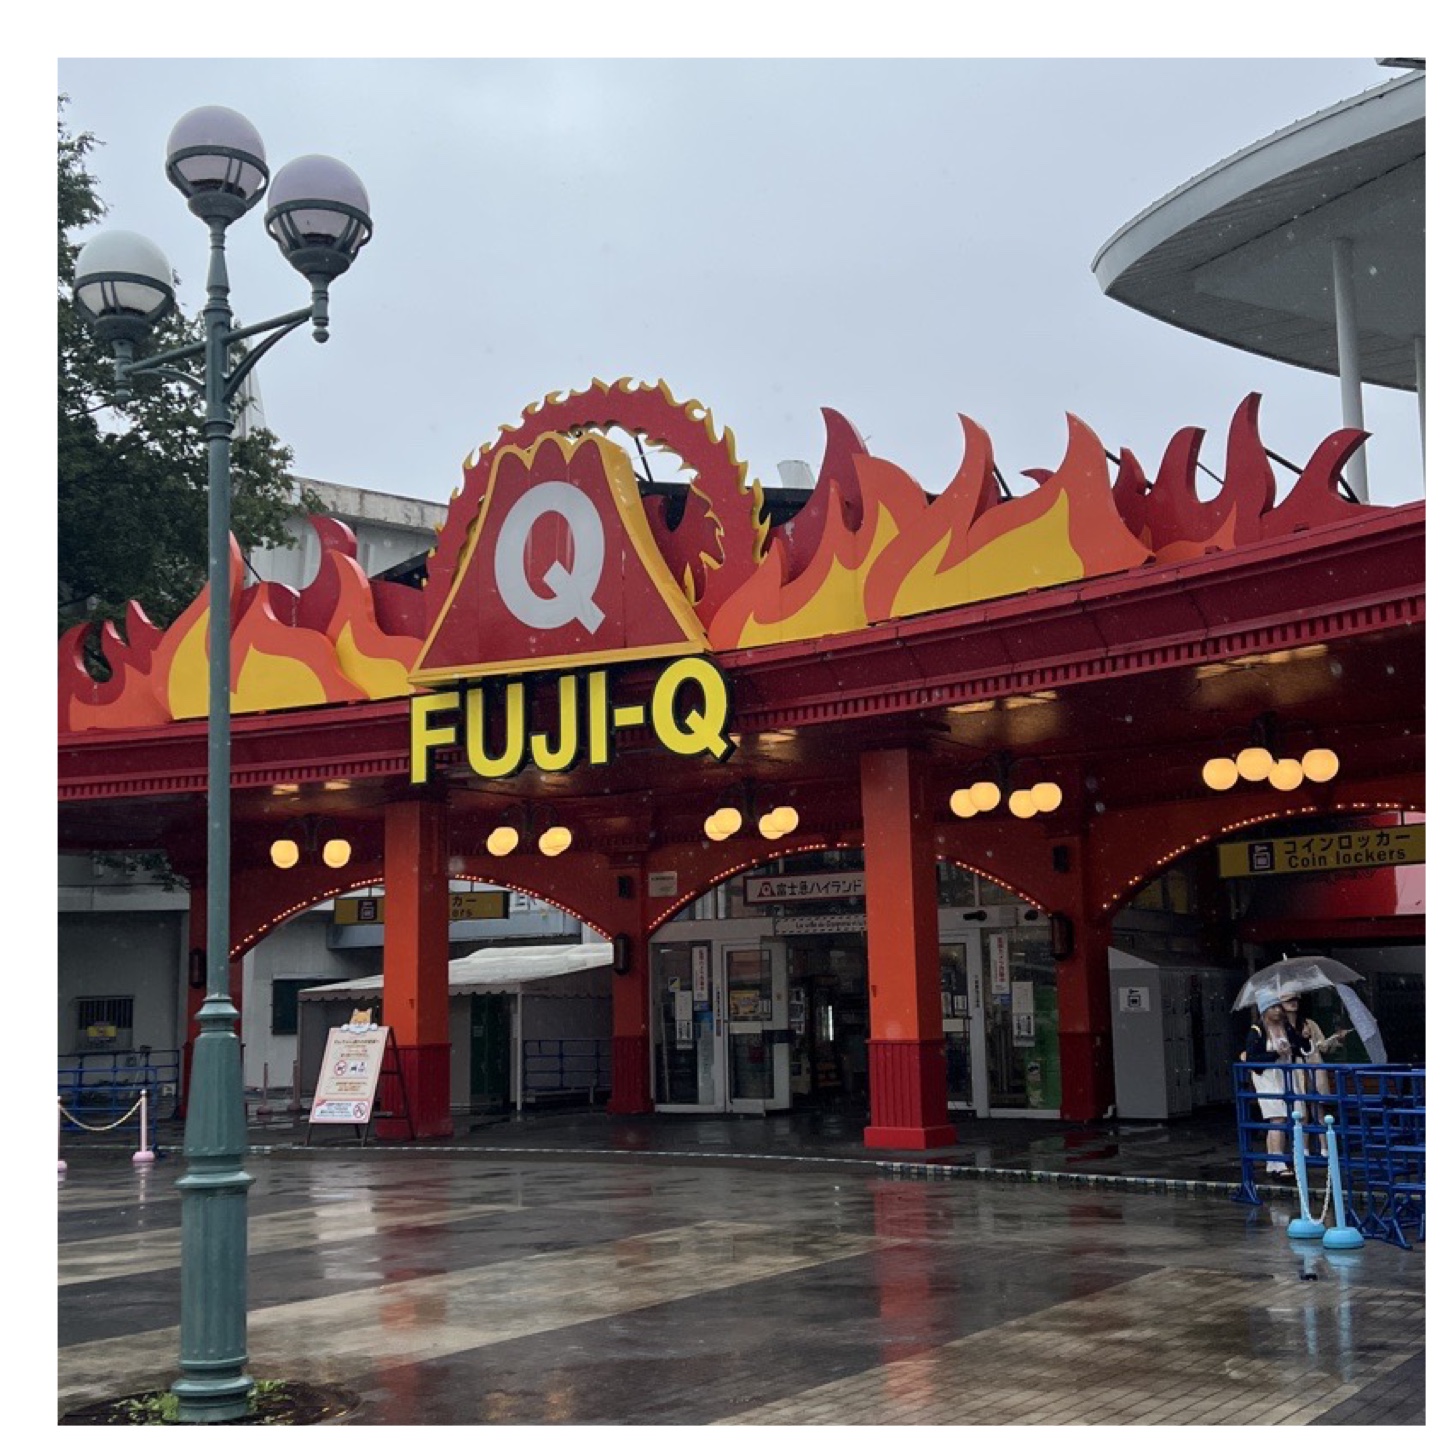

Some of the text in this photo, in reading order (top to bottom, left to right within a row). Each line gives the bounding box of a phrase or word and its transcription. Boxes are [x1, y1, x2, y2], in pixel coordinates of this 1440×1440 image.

[494, 481, 606, 635] Q
[410, 657, 737, 784] FUJI-Q
[1284, 831, 1410, 854] コインロッカー
[1288, 849, 1406, 869] Coin lockers
[776, 880, 862, 896] 富士急ハイランド
